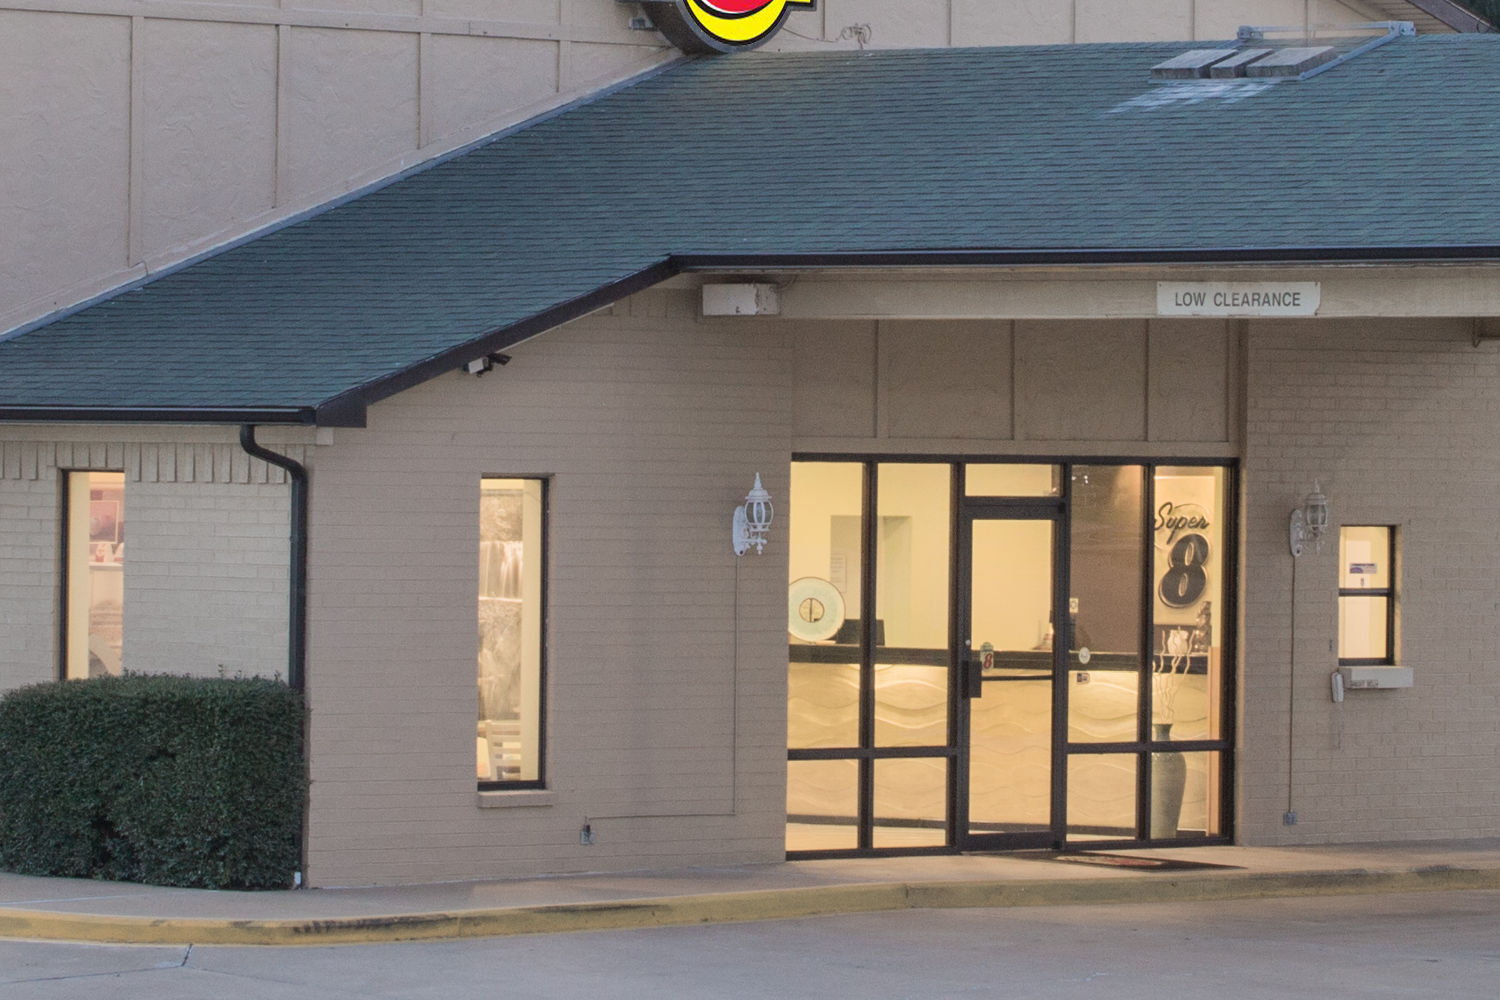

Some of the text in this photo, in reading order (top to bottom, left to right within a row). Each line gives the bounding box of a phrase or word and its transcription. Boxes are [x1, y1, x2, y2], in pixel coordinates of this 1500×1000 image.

[1175, 292, 1301, 307] LOW CLEARANCE
[1154, 502, 1209, 544] Super
[1158, 534, 1209, 608] 8
